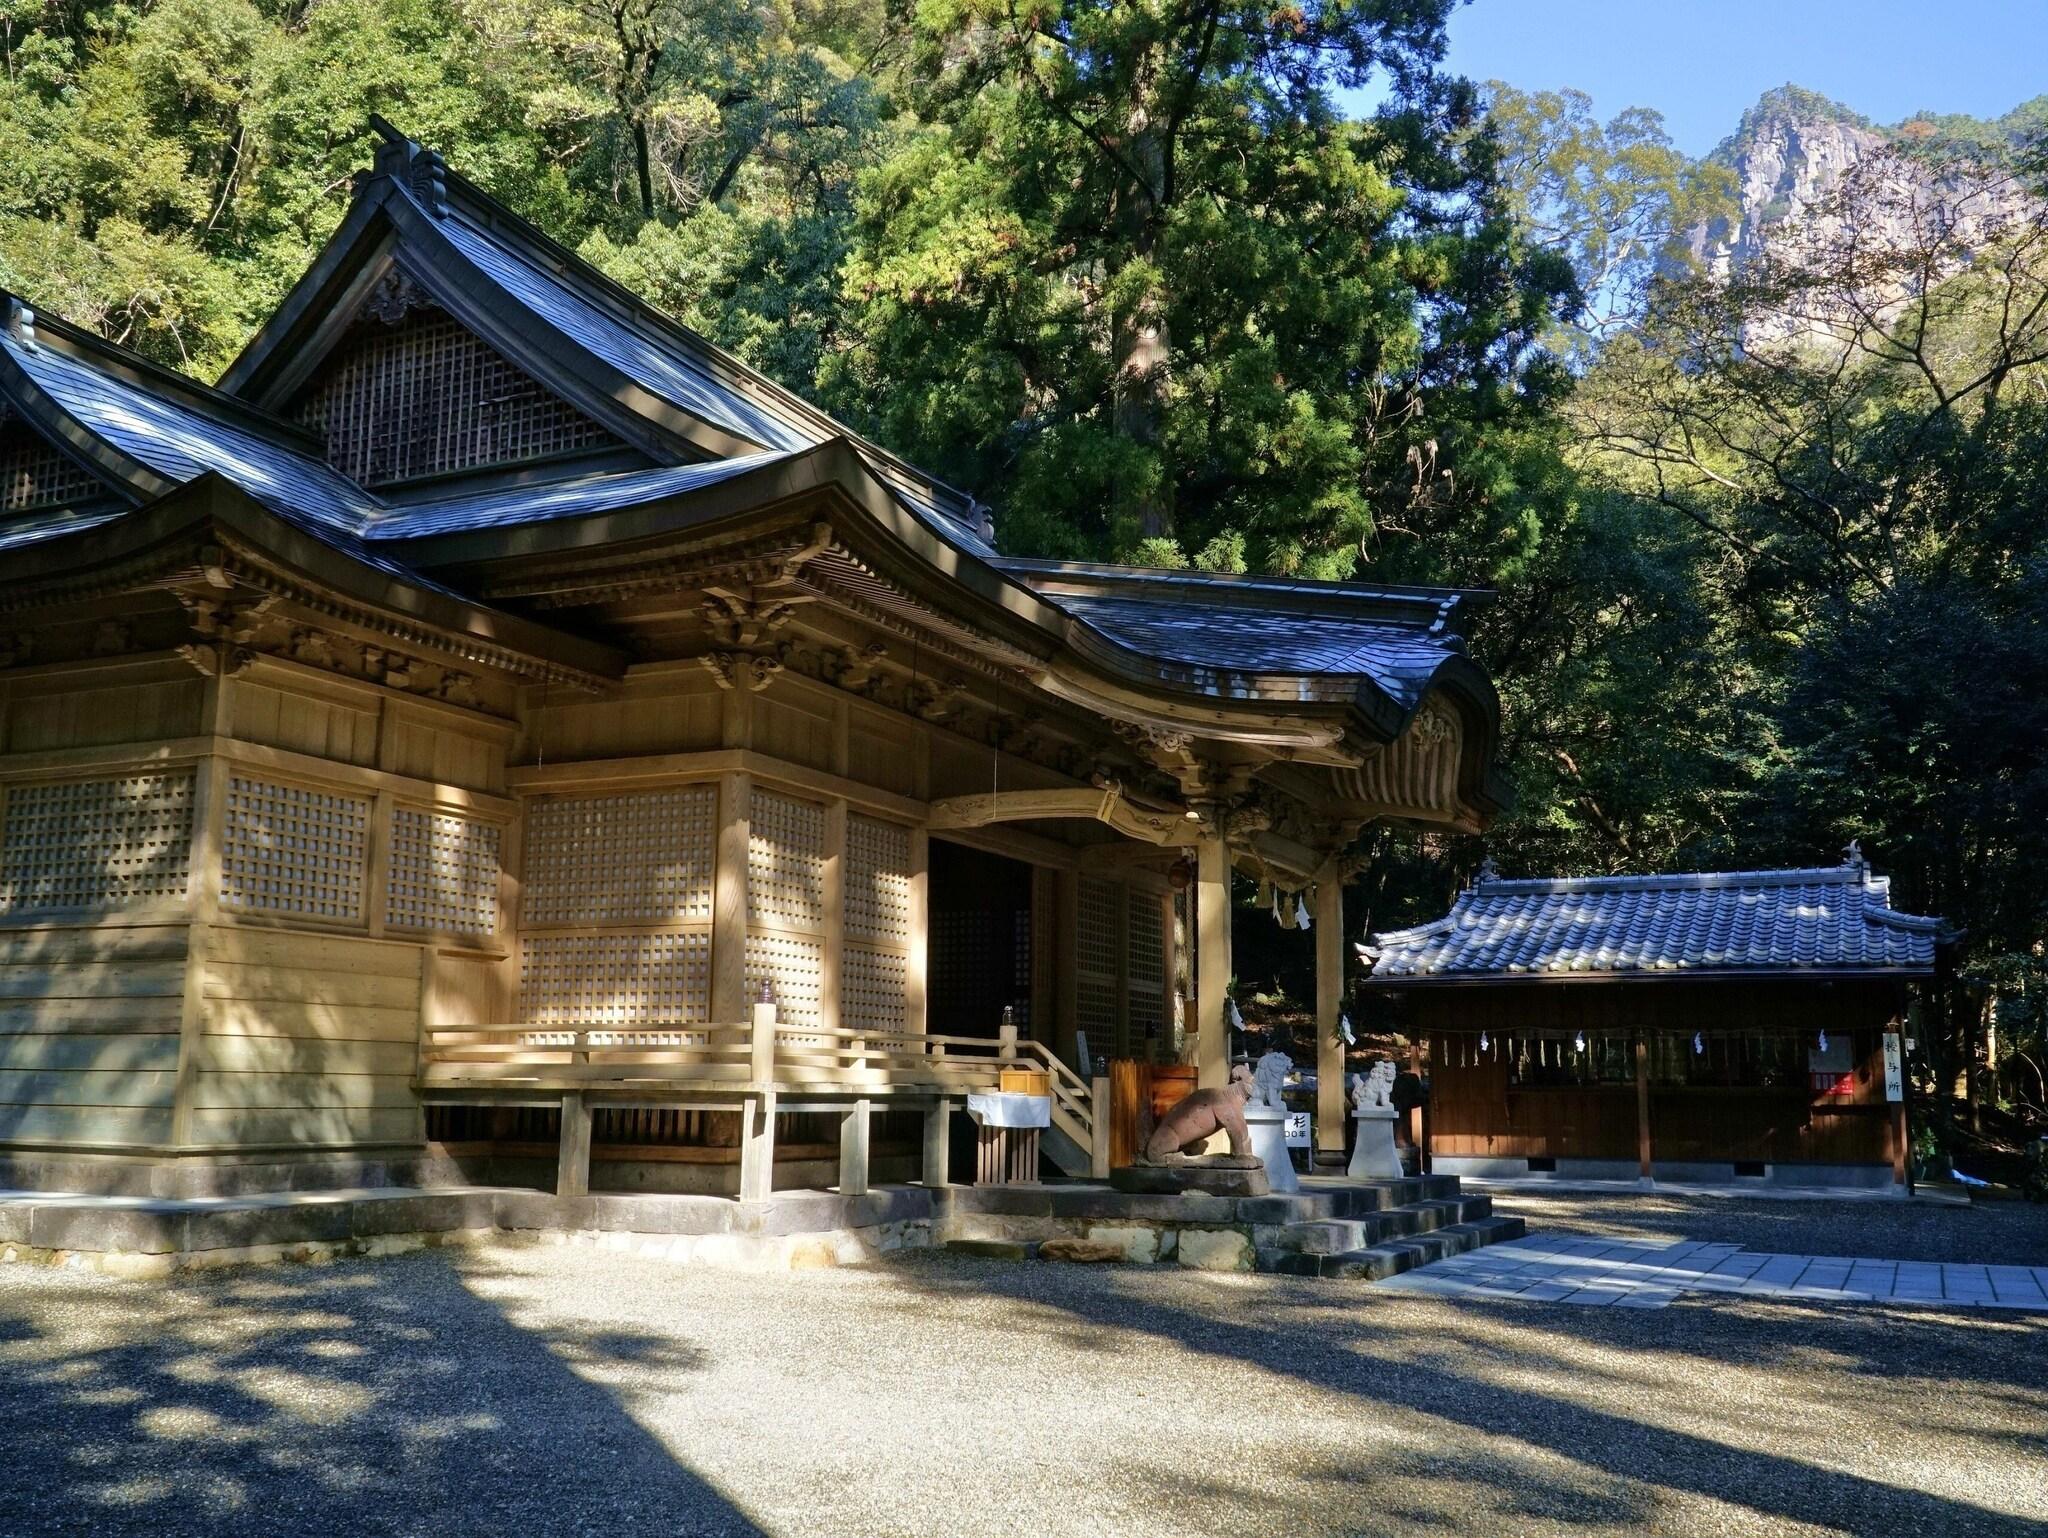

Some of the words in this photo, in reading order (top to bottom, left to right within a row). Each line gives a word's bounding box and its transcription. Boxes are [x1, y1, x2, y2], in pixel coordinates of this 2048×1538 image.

[1885, 1041, 1900, 1093] 授与所
[1293, 1115, 1306, 1128] 杉
